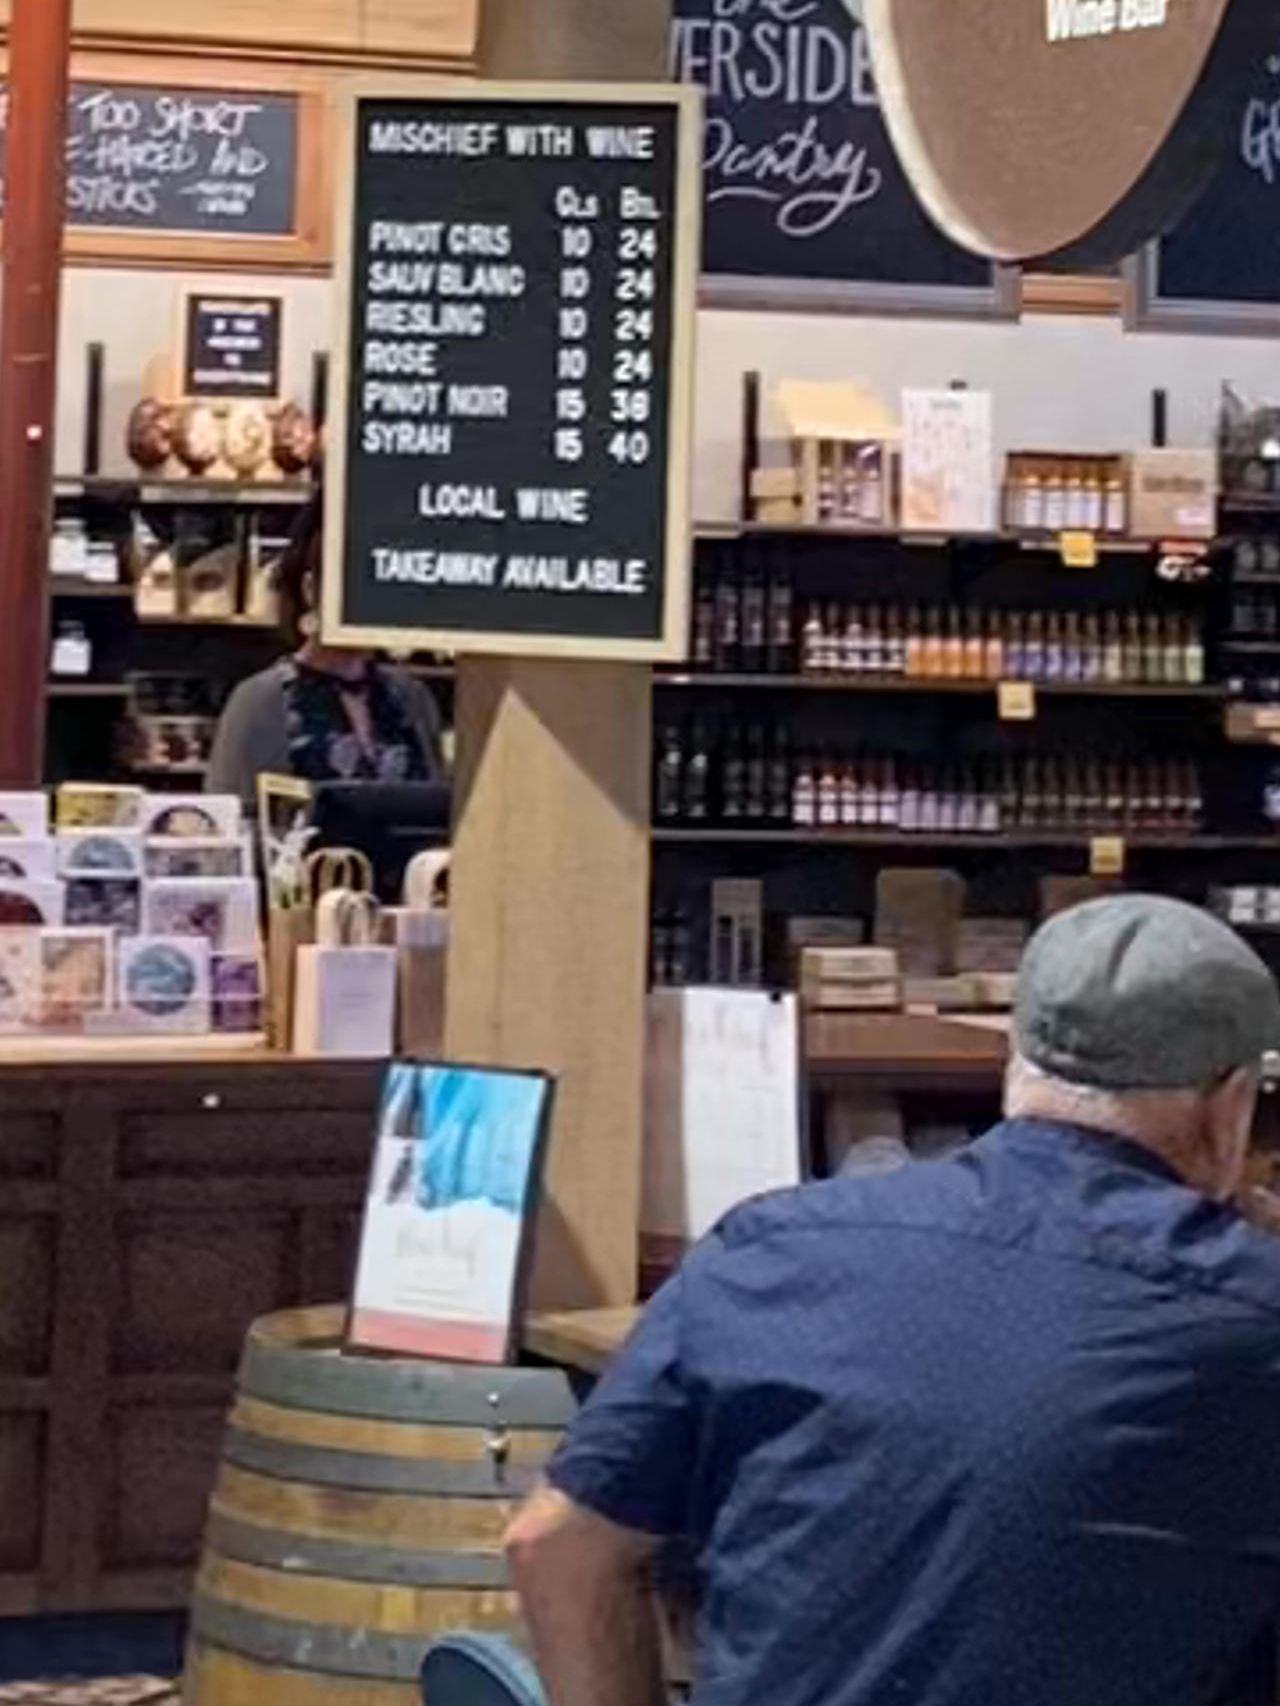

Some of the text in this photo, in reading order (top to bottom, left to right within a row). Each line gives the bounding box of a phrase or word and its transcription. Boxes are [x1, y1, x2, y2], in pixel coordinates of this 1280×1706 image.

[673, 18, 881, 105] ERSIDE
[77, 89, 264, 139] TOO SHORT
[369, 121, 655, 159] MISCHIEF WITH WINE
[369, 221, 445, 253] PINOT
[561, 226, 593, 258] 10
[617, 228, 657, 260] 24
[368, 261, 655, 301] SAUV BLANC 10 24
[366, 301, 653, 341] RIESLING 10 24
[364, 341, 653, 382] ROSE 10 24
[363, 381, 651, 422] PINOT NOIR 15 38
[362, 421, 650, 463] SYRAH 15 40
[419, 483, 588, 522] LOCAL WINE
[370, 547, 647, 593] TAKEAWAY AVAILABLE
